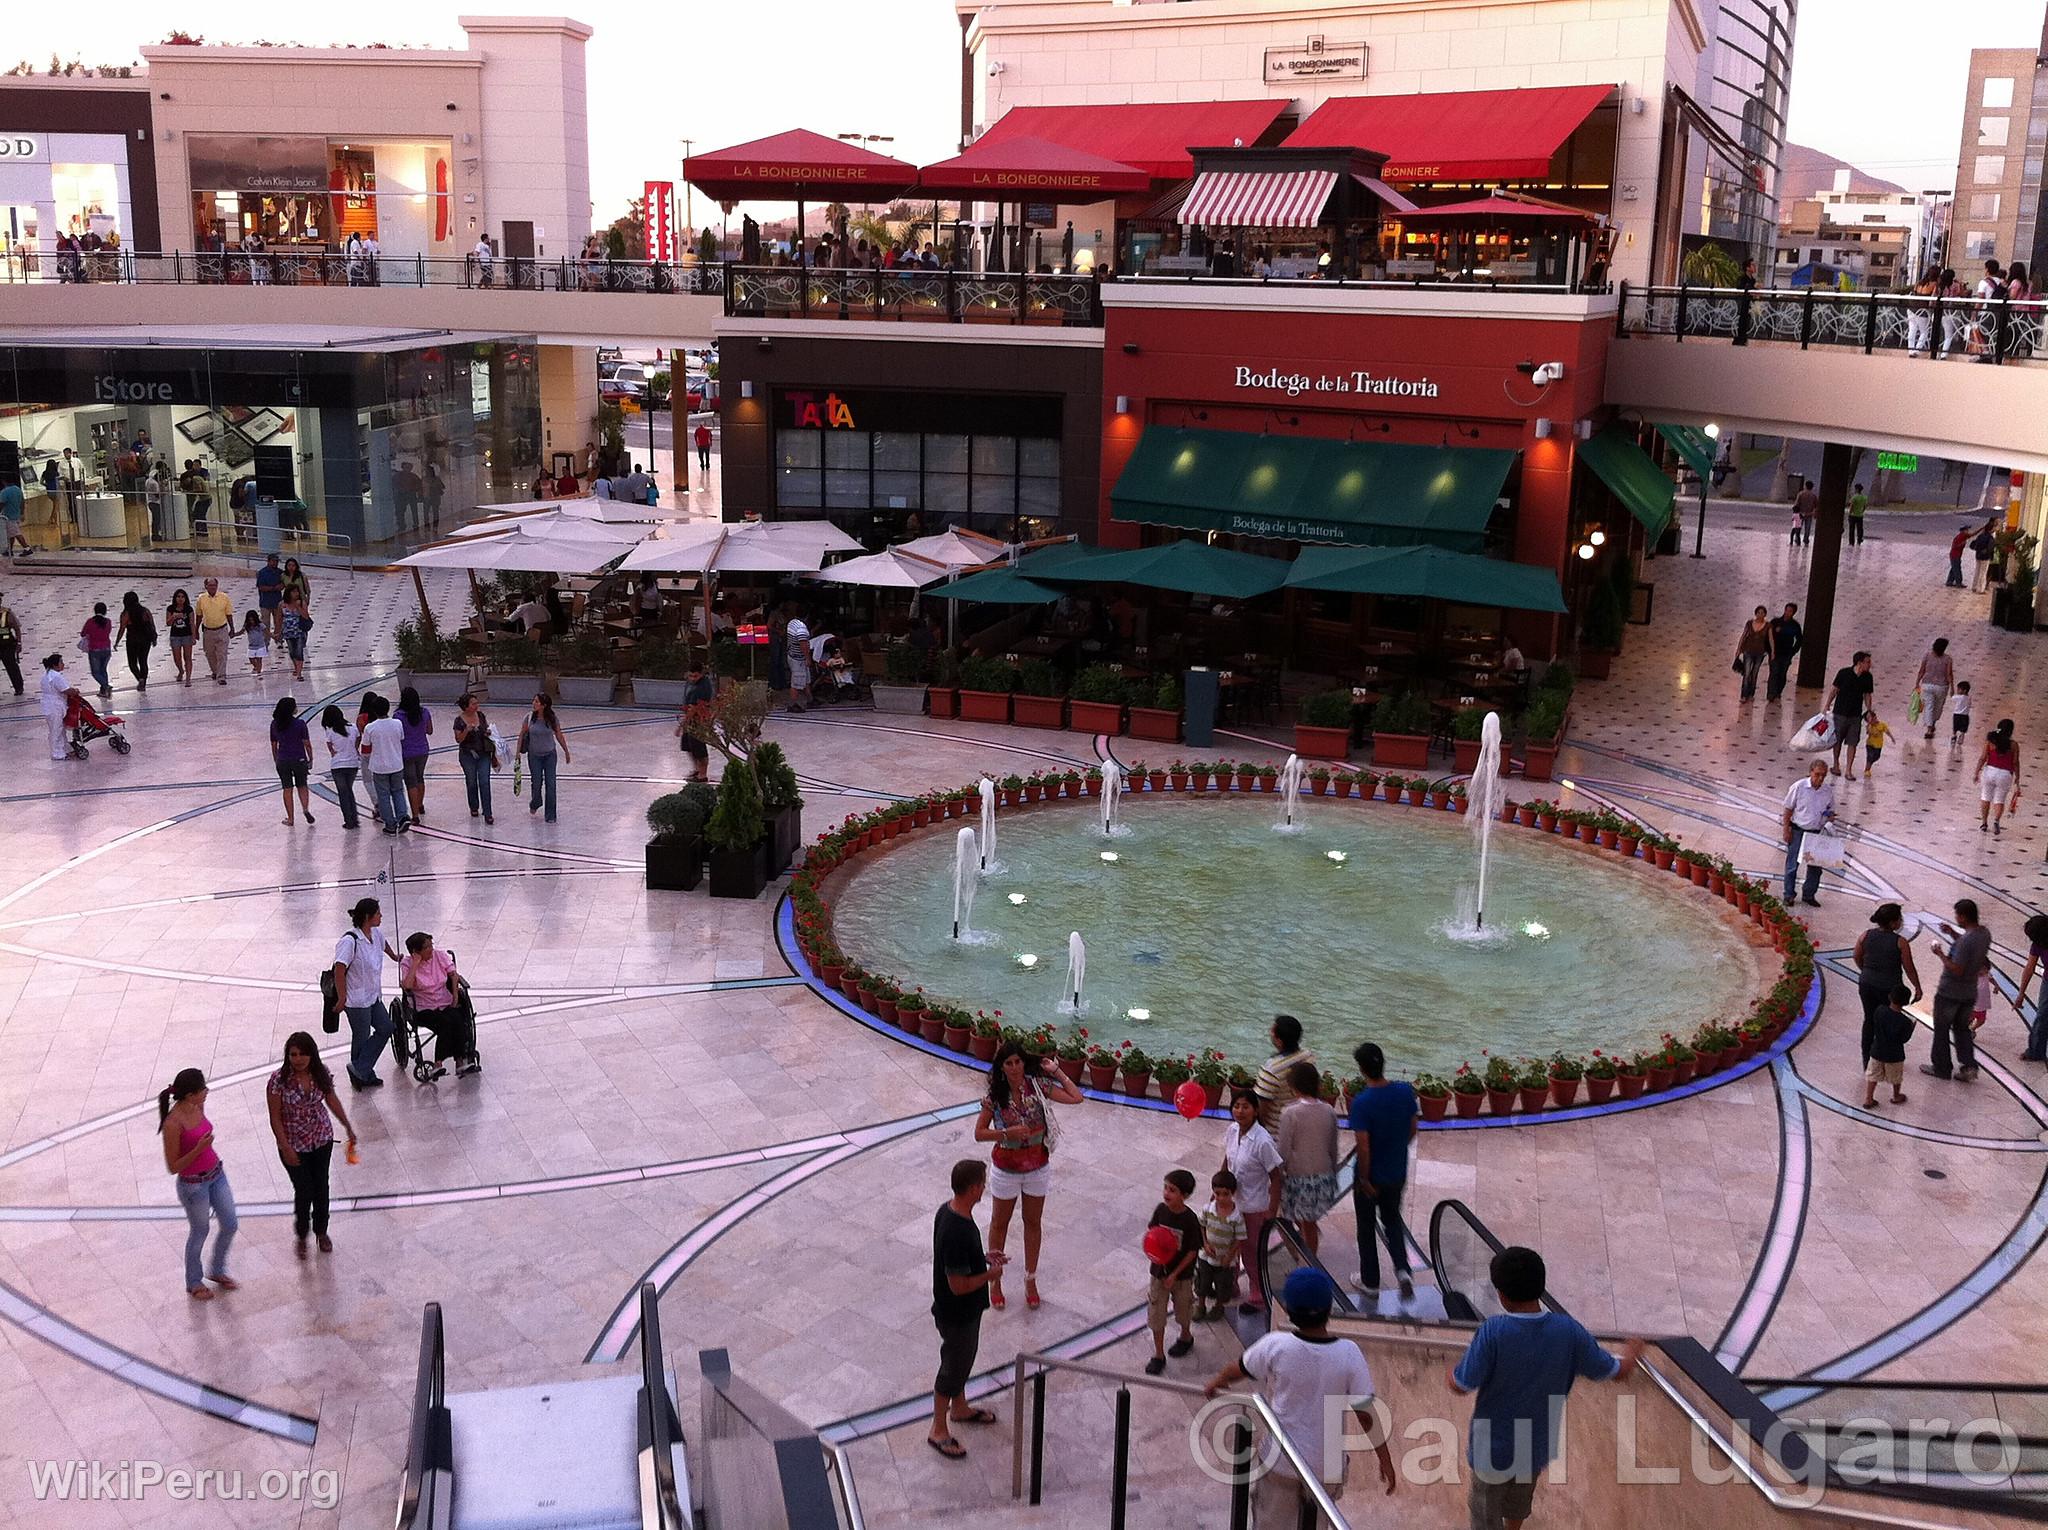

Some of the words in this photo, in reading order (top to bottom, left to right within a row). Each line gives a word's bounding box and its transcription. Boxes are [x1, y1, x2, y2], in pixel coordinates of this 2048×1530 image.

[1272, 62, 1284, 70] LA
[1288, 58, 1359, 69] BONBONNIERE
[734, 166, 752, 177] LA
[760, 166, 867, 179] BONBONNIERE
[1381, 166, 1440, 177] BONNIERE
[973, 173, 991, 184] LA
[997, 174, 1100, 186] BONBONNIERE
[94, 375, 173, 401] iStore
[1235, 366, 1310, 397] Bodega
[1315, 375, 1335, 391] de
[1336, 376, 1349, 392] la
[1351, 371, 1438, 397] Trattoria
[1232, 516, 1270, 533] Bodega
[1272, 521, 1285, 533] de
[1287, 522, 1296, 533] la
[1298, 522, 1344, 537] Trattoria
